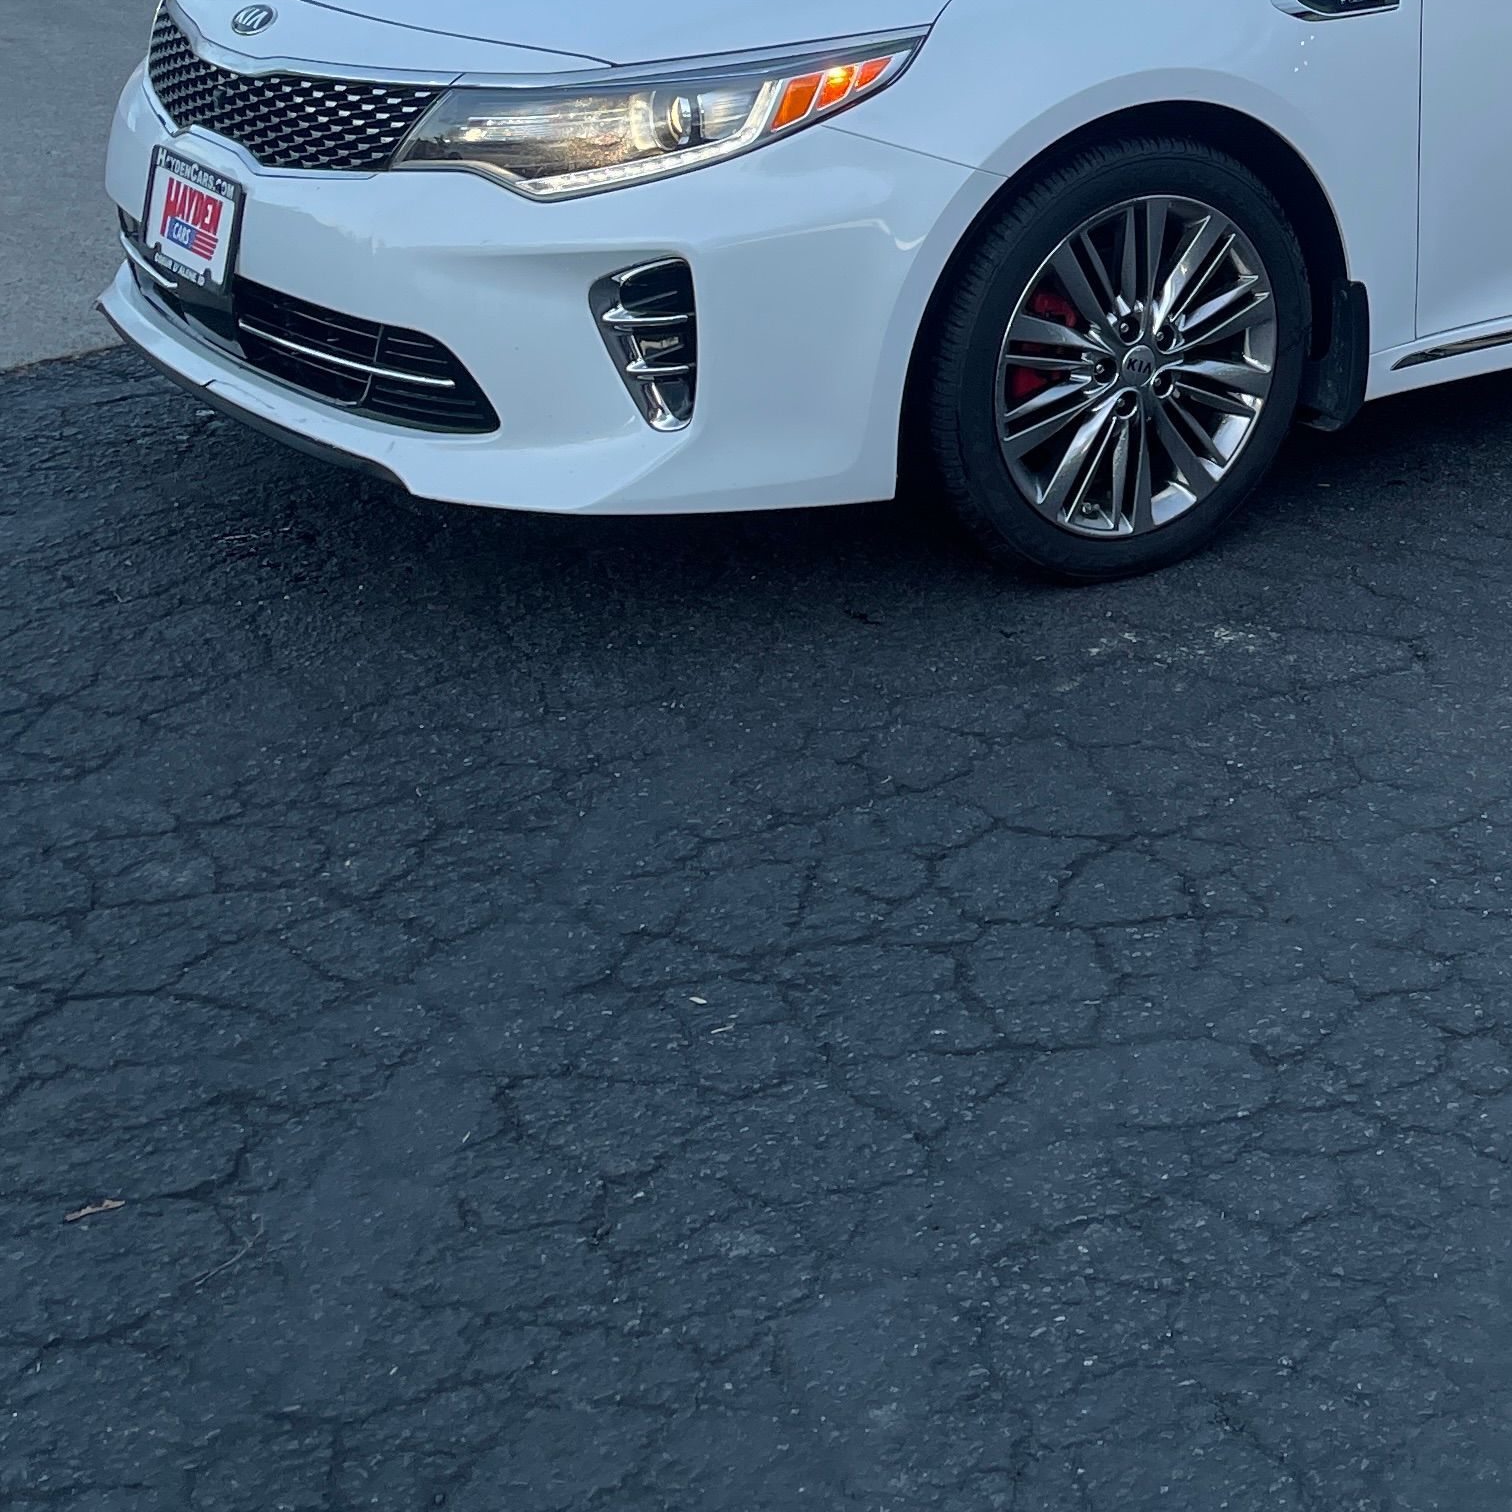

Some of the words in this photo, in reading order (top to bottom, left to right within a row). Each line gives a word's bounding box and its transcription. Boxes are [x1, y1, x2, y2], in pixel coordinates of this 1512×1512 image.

[234, 7, 268, 29] KIA
[160, 176, 224, 238] HAYDEN
[171, 222, 192, 246] CARS
[1126, 358, 1152, 374] KIA
